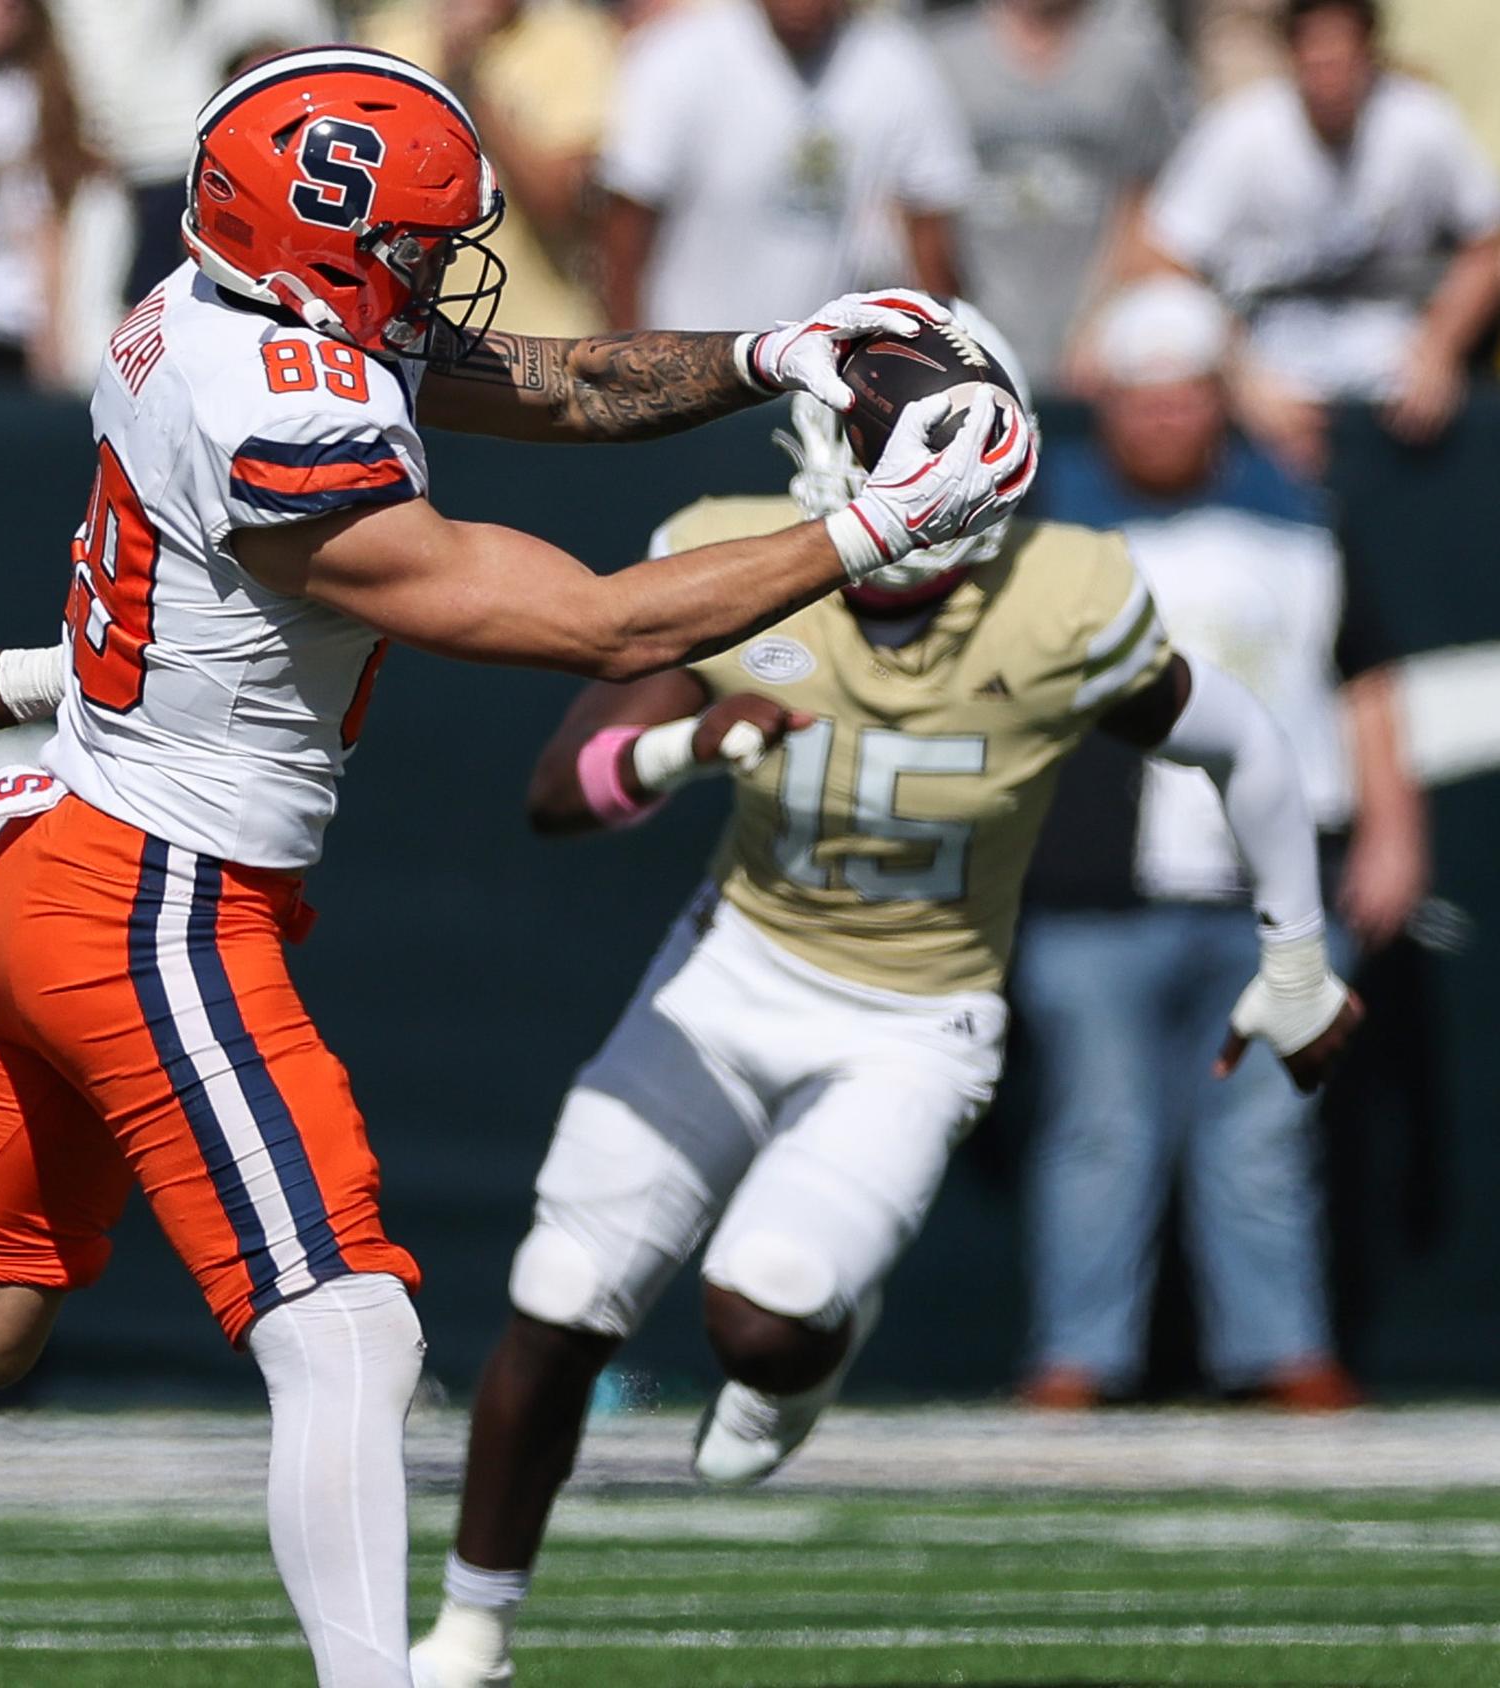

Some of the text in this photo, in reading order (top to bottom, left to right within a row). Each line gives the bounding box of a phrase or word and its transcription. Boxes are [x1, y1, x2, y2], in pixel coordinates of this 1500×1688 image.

[288, 116, 386, 232] S
[260, 339, 370, 404] 89
[770, 716, 988, 903] 15
